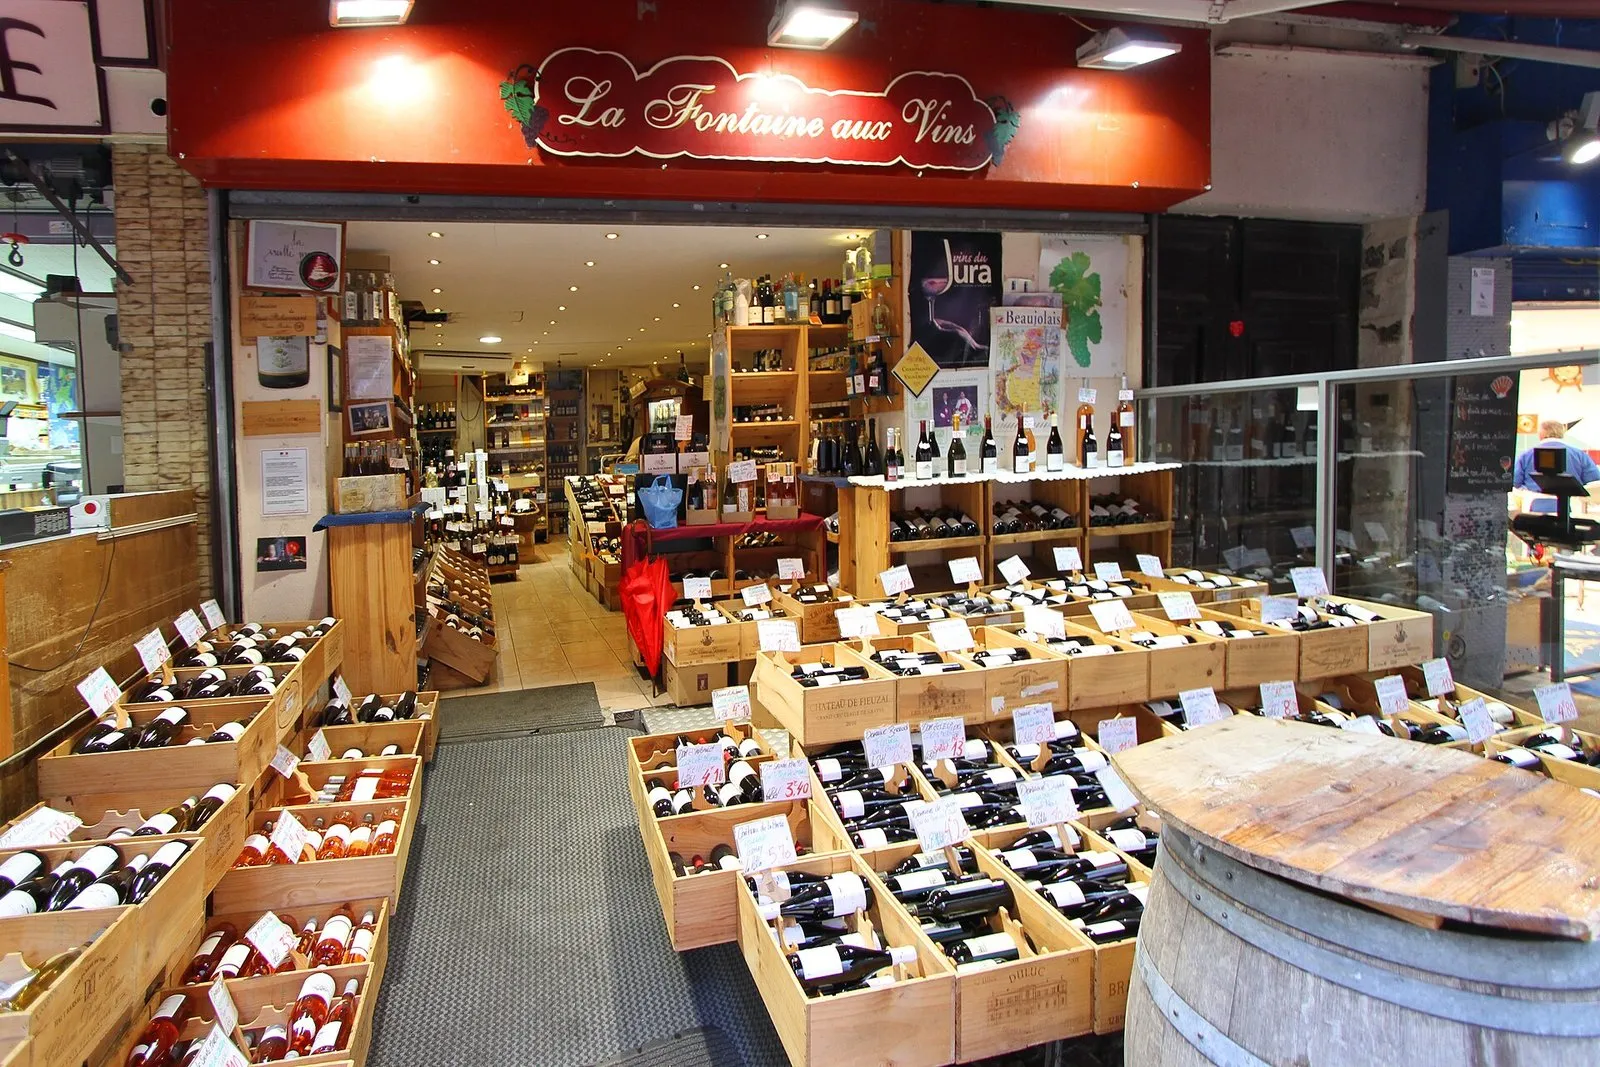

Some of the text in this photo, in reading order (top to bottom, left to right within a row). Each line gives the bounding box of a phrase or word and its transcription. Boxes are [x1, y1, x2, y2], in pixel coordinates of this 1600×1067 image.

[558, 76, 976, 144] La Fontaine aux Vins
[952, 251, 989, 263] vins du
[1006, 311, 1061, 326] Beaujolais
[847, 698, 858, 708] DE
[1109, 981, 1126, 996] BR
